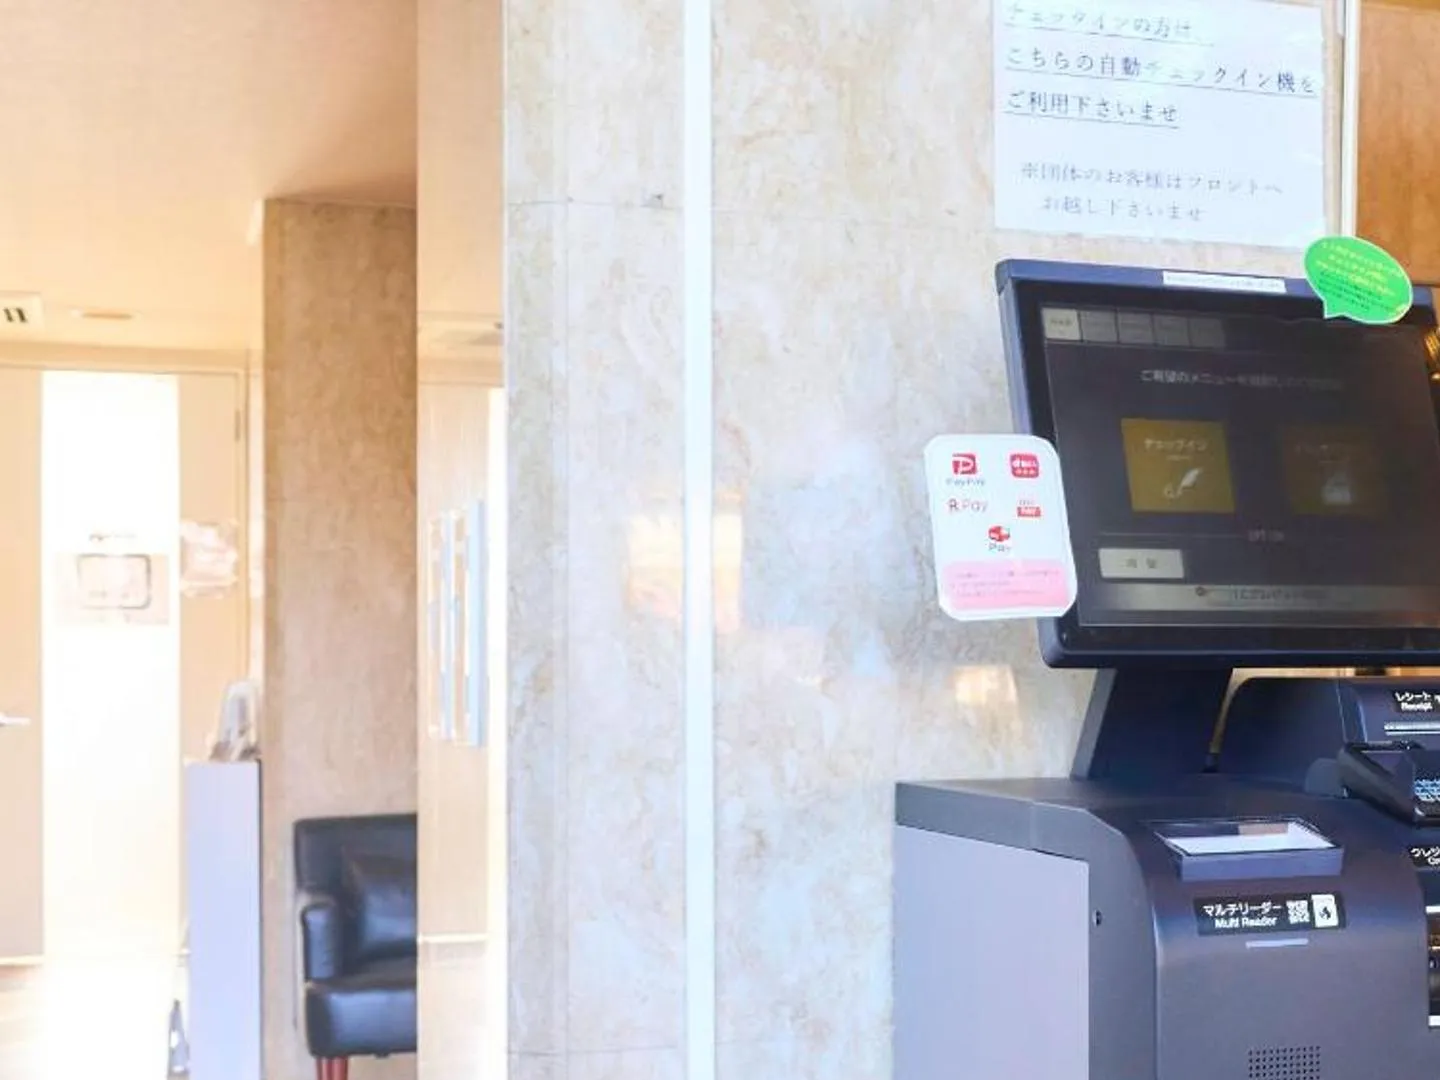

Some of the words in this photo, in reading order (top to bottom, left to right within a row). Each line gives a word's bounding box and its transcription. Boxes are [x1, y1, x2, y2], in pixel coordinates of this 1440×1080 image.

[1007, 46, 1316, 95] こちらの自動チェックイン機を
[1007, 91, 1179, 123] ご利用下さいませ
[1395, 691, 1431, 702] レシート
[1203, 901, 1281, 916] マルチリーダー
[1215, 917, 1239, 928] Multi
[1242, 916, 1276, 927] Reader
